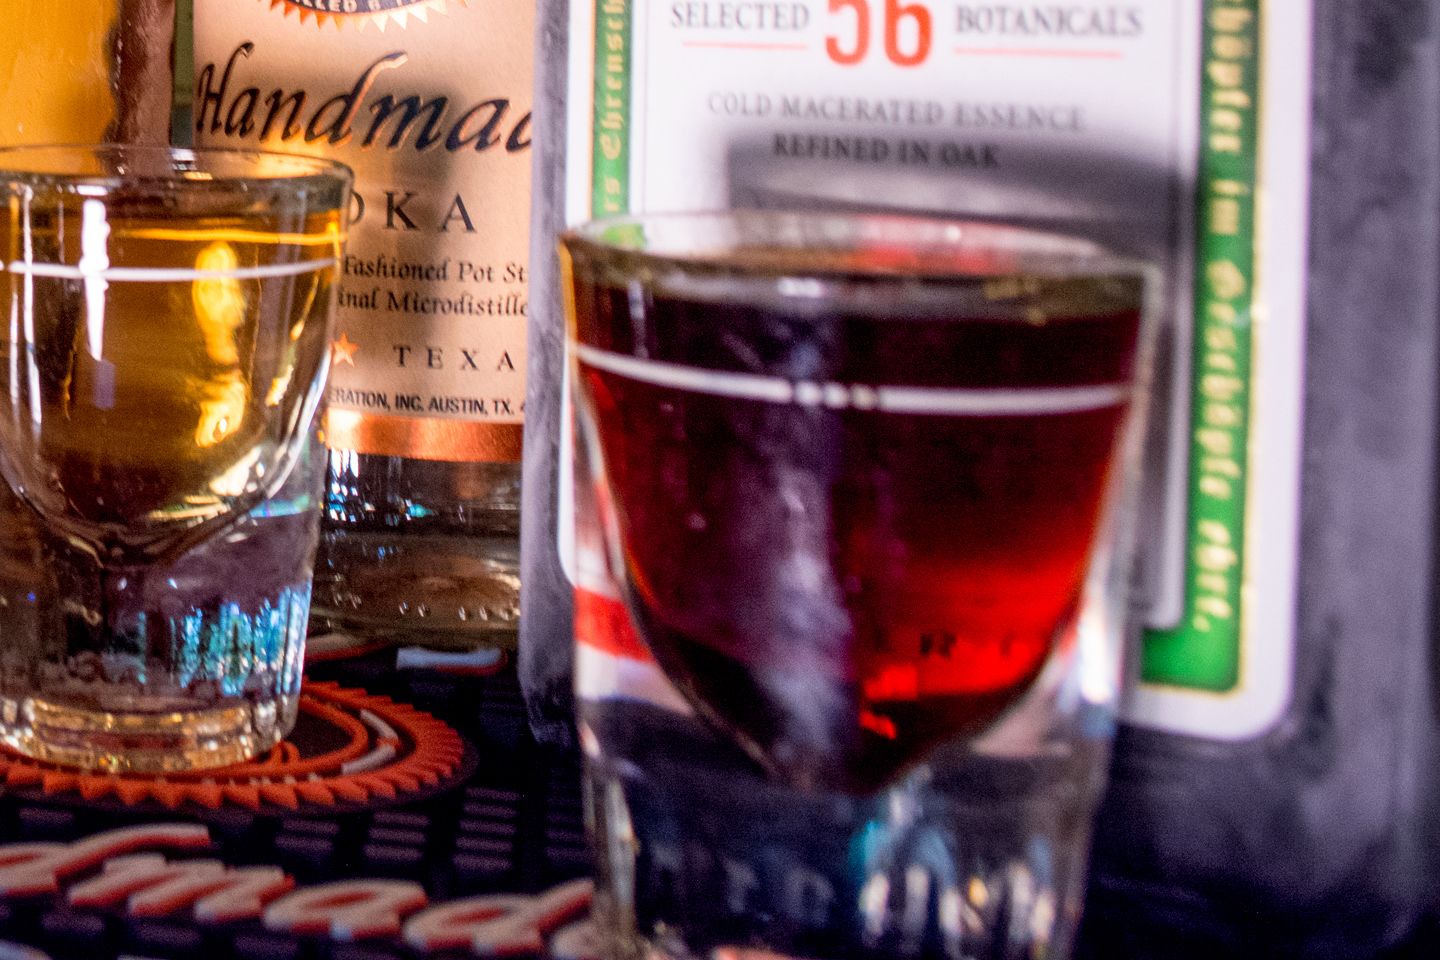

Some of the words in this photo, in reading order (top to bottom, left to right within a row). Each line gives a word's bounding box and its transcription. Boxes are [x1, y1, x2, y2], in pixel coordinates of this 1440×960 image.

[670, 2, 810, 31] SELECTED
[955, 2, 1143, 38] BOTANICALS
[708, 91, 772, 117] COLD
[781, 94, 944, 127] MACERATED
[953, 101, 1086, 131] ESSENCE
[771, 134, 889, 163] REFINED
[898, 138, 930, 165] IN
[940, 140, 1000, 168] OAK
[459, 262, 494, 283] Pot
[395, 395, 423, 411] INC.
[428, 397, 488, 416] AUSTIN,
[494, 399, 516, 416] TX.
